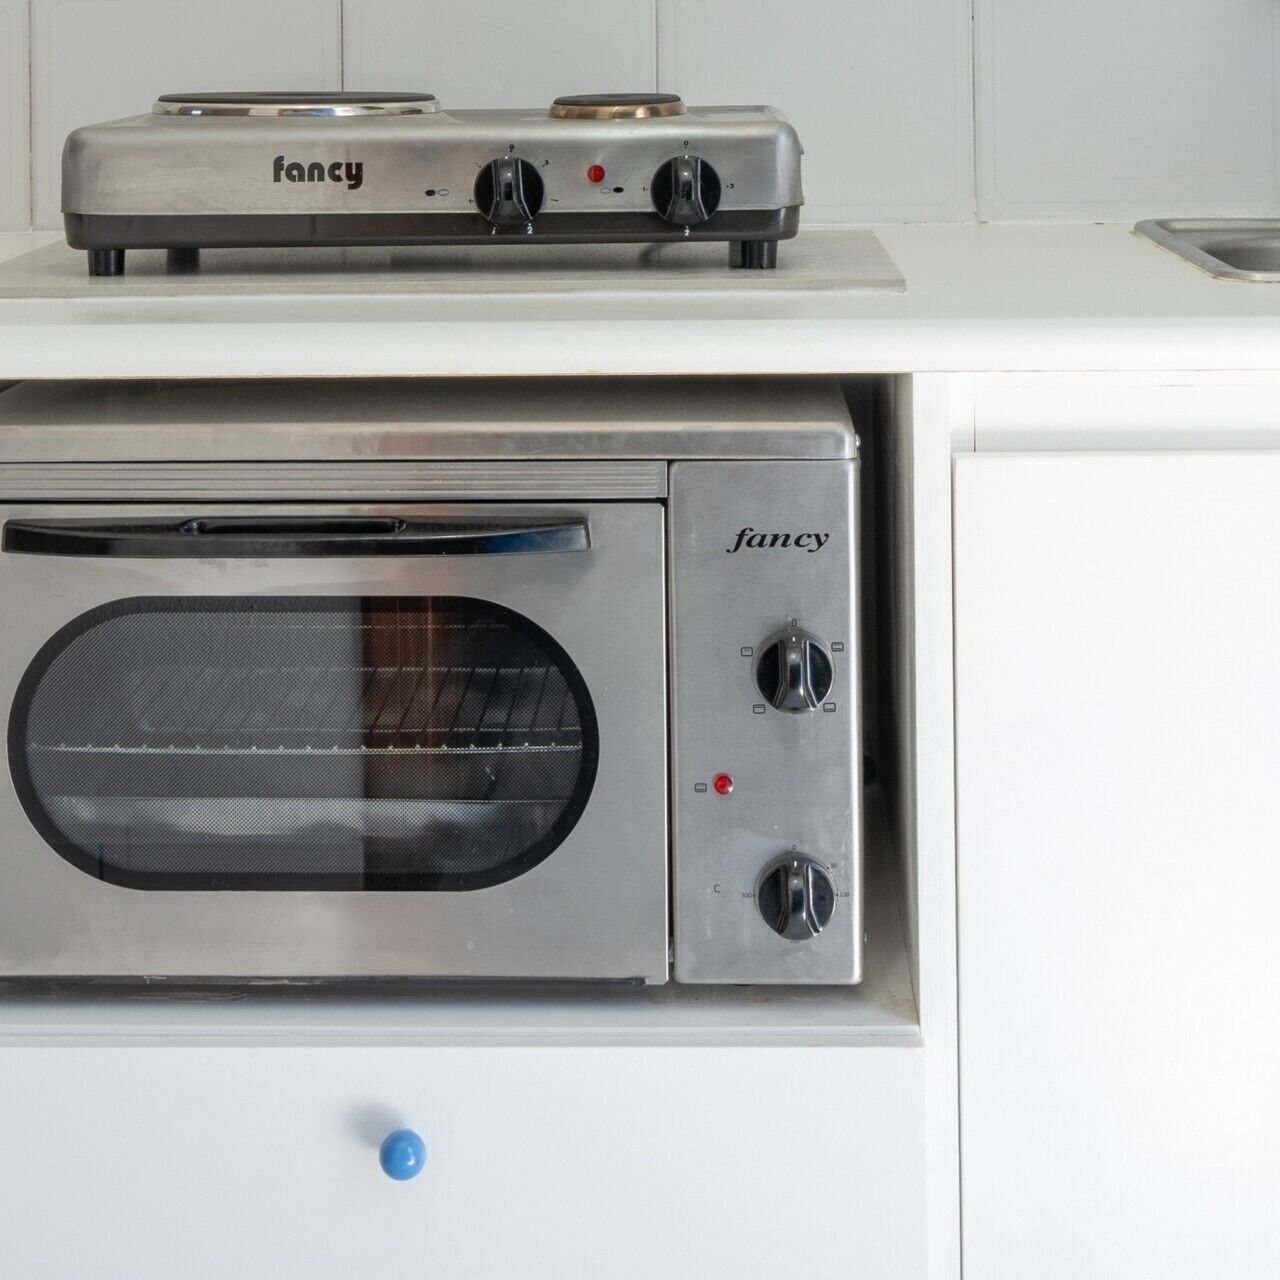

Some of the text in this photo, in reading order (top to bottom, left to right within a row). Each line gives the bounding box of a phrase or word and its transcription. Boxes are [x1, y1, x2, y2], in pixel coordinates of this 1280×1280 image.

[273, 156, 363, 190] fancy
[726, 527, 829, 553] fancy
[791, 618, 798, 628] 0
